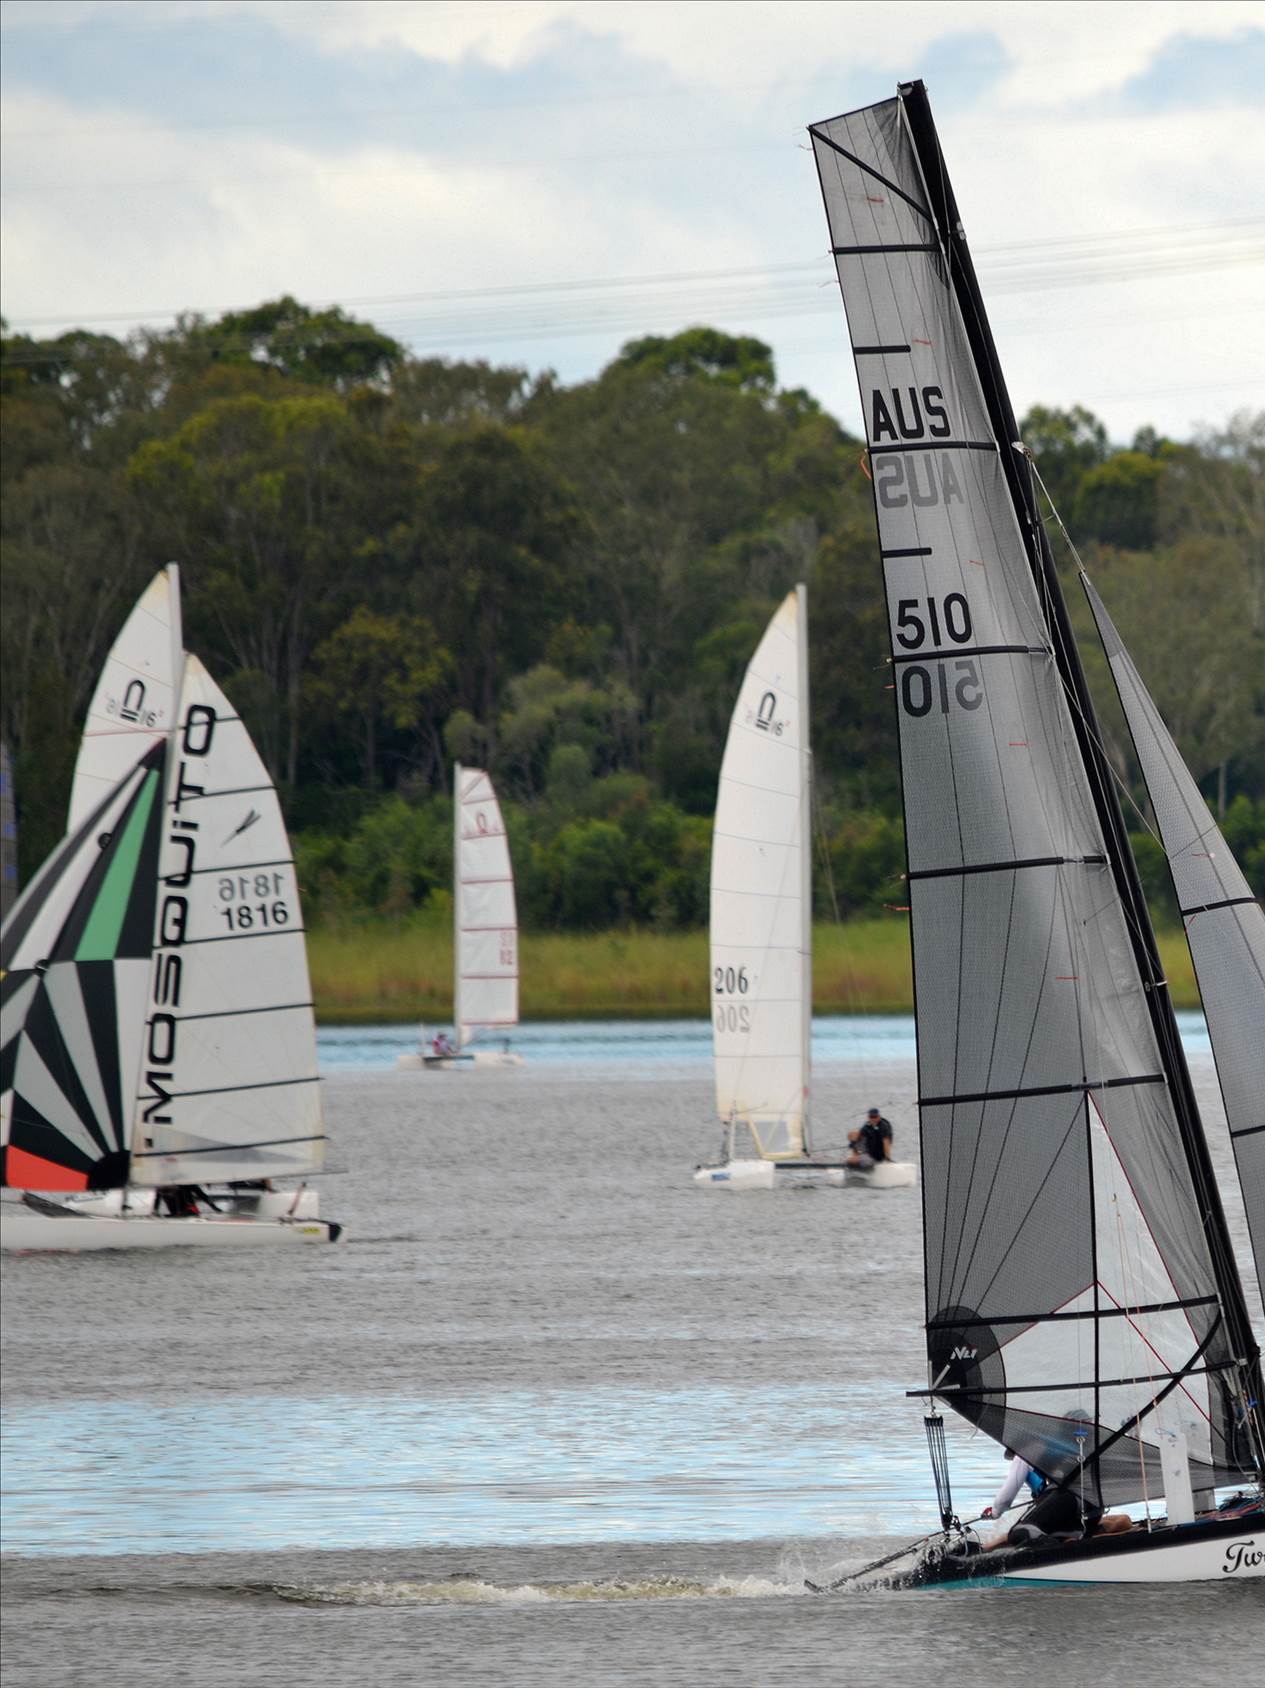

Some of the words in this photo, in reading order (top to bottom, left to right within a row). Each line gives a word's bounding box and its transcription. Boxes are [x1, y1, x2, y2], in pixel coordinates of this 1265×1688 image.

[872, 385, 951, 442] AUS
[896, 592, 972, 650] 510
[220, 900, 288, 931] 1816
[715, 966, 749, 994] 206
